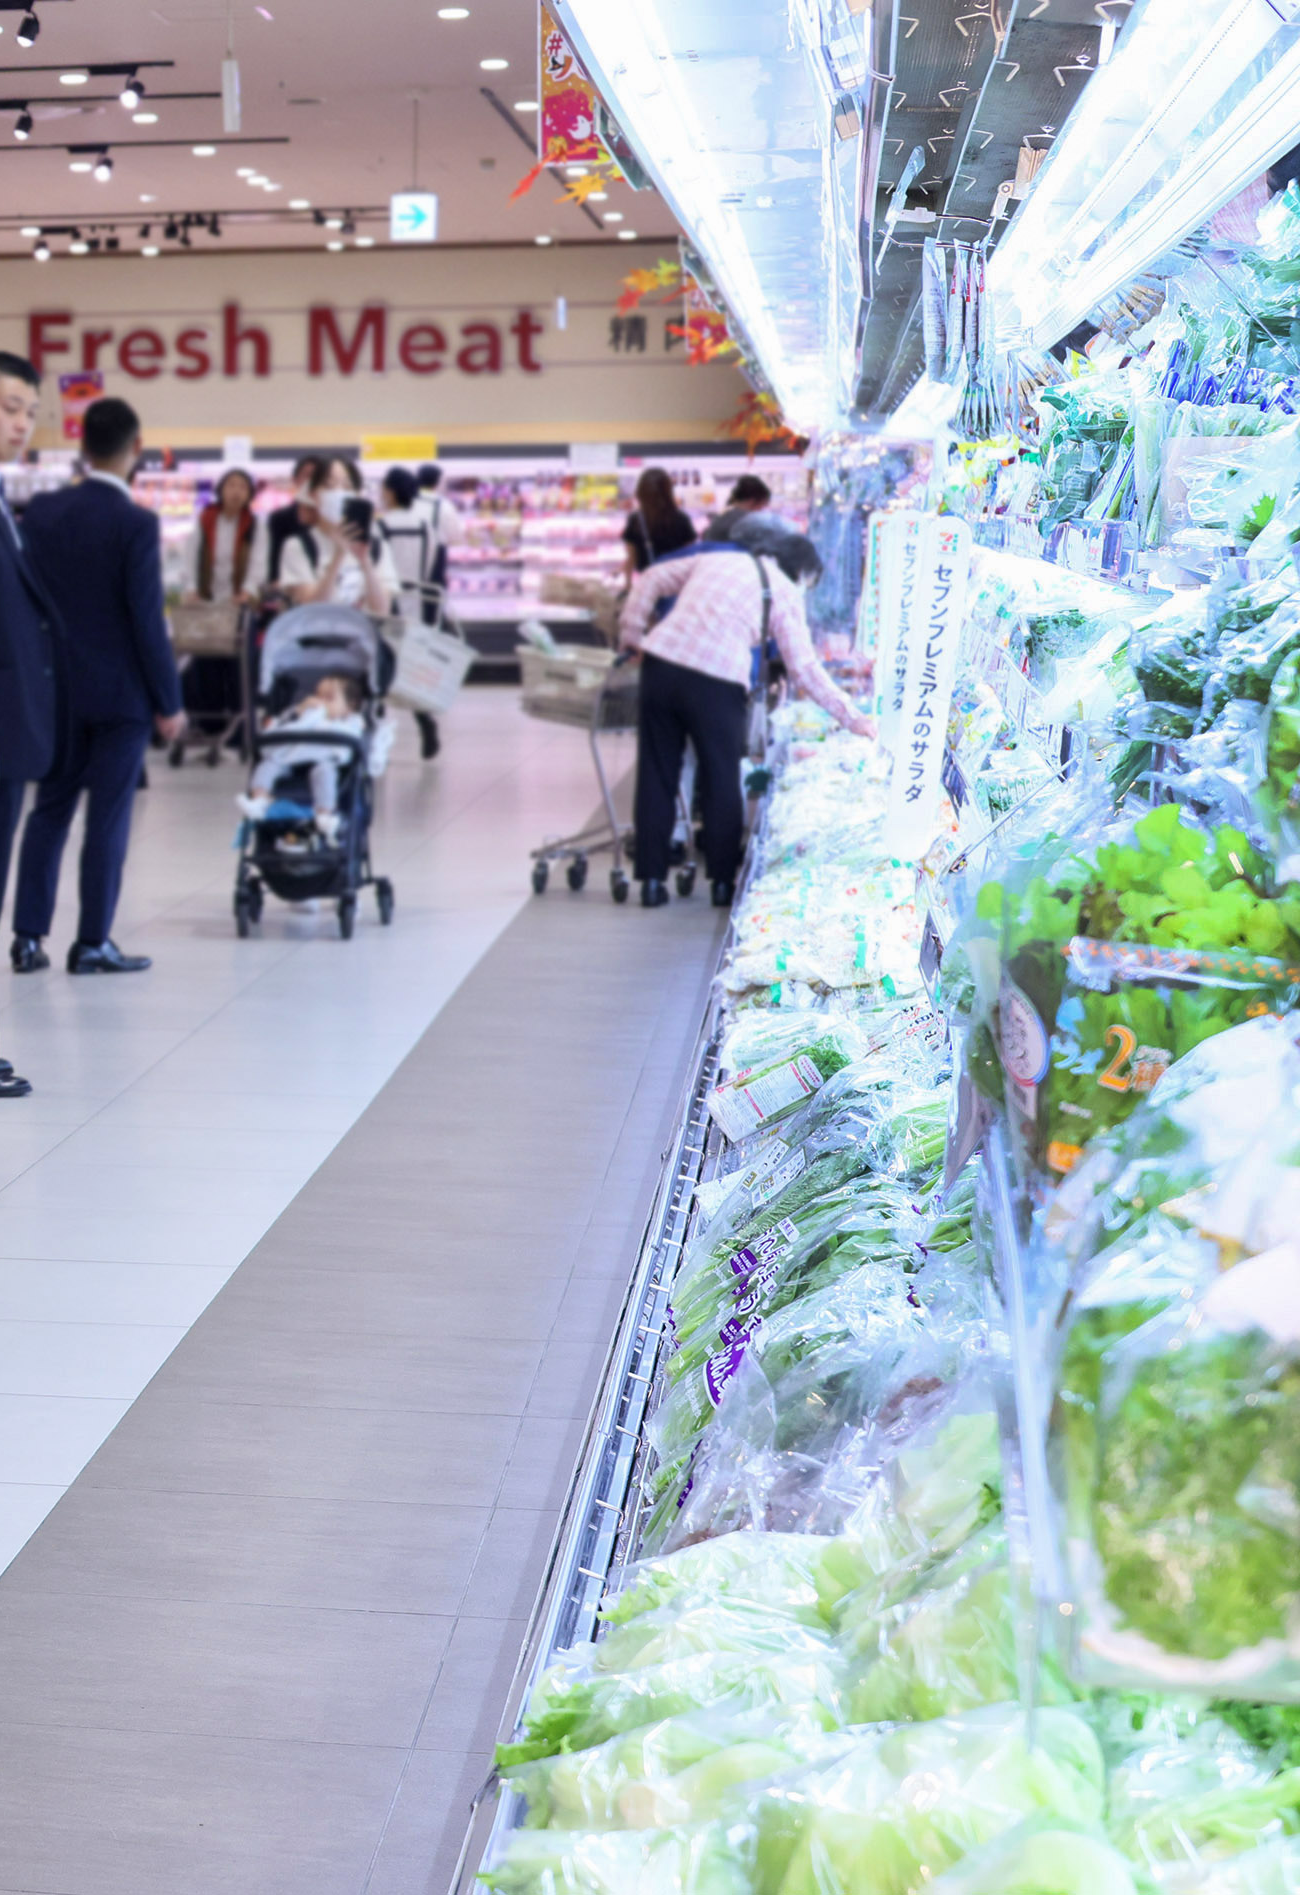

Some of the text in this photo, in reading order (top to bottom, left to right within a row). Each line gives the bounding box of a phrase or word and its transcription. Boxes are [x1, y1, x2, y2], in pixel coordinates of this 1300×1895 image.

[27, 302, 543, 380] Fresh Meat
[905, 564, 953, 803] セブンプレミアムのサラダ
